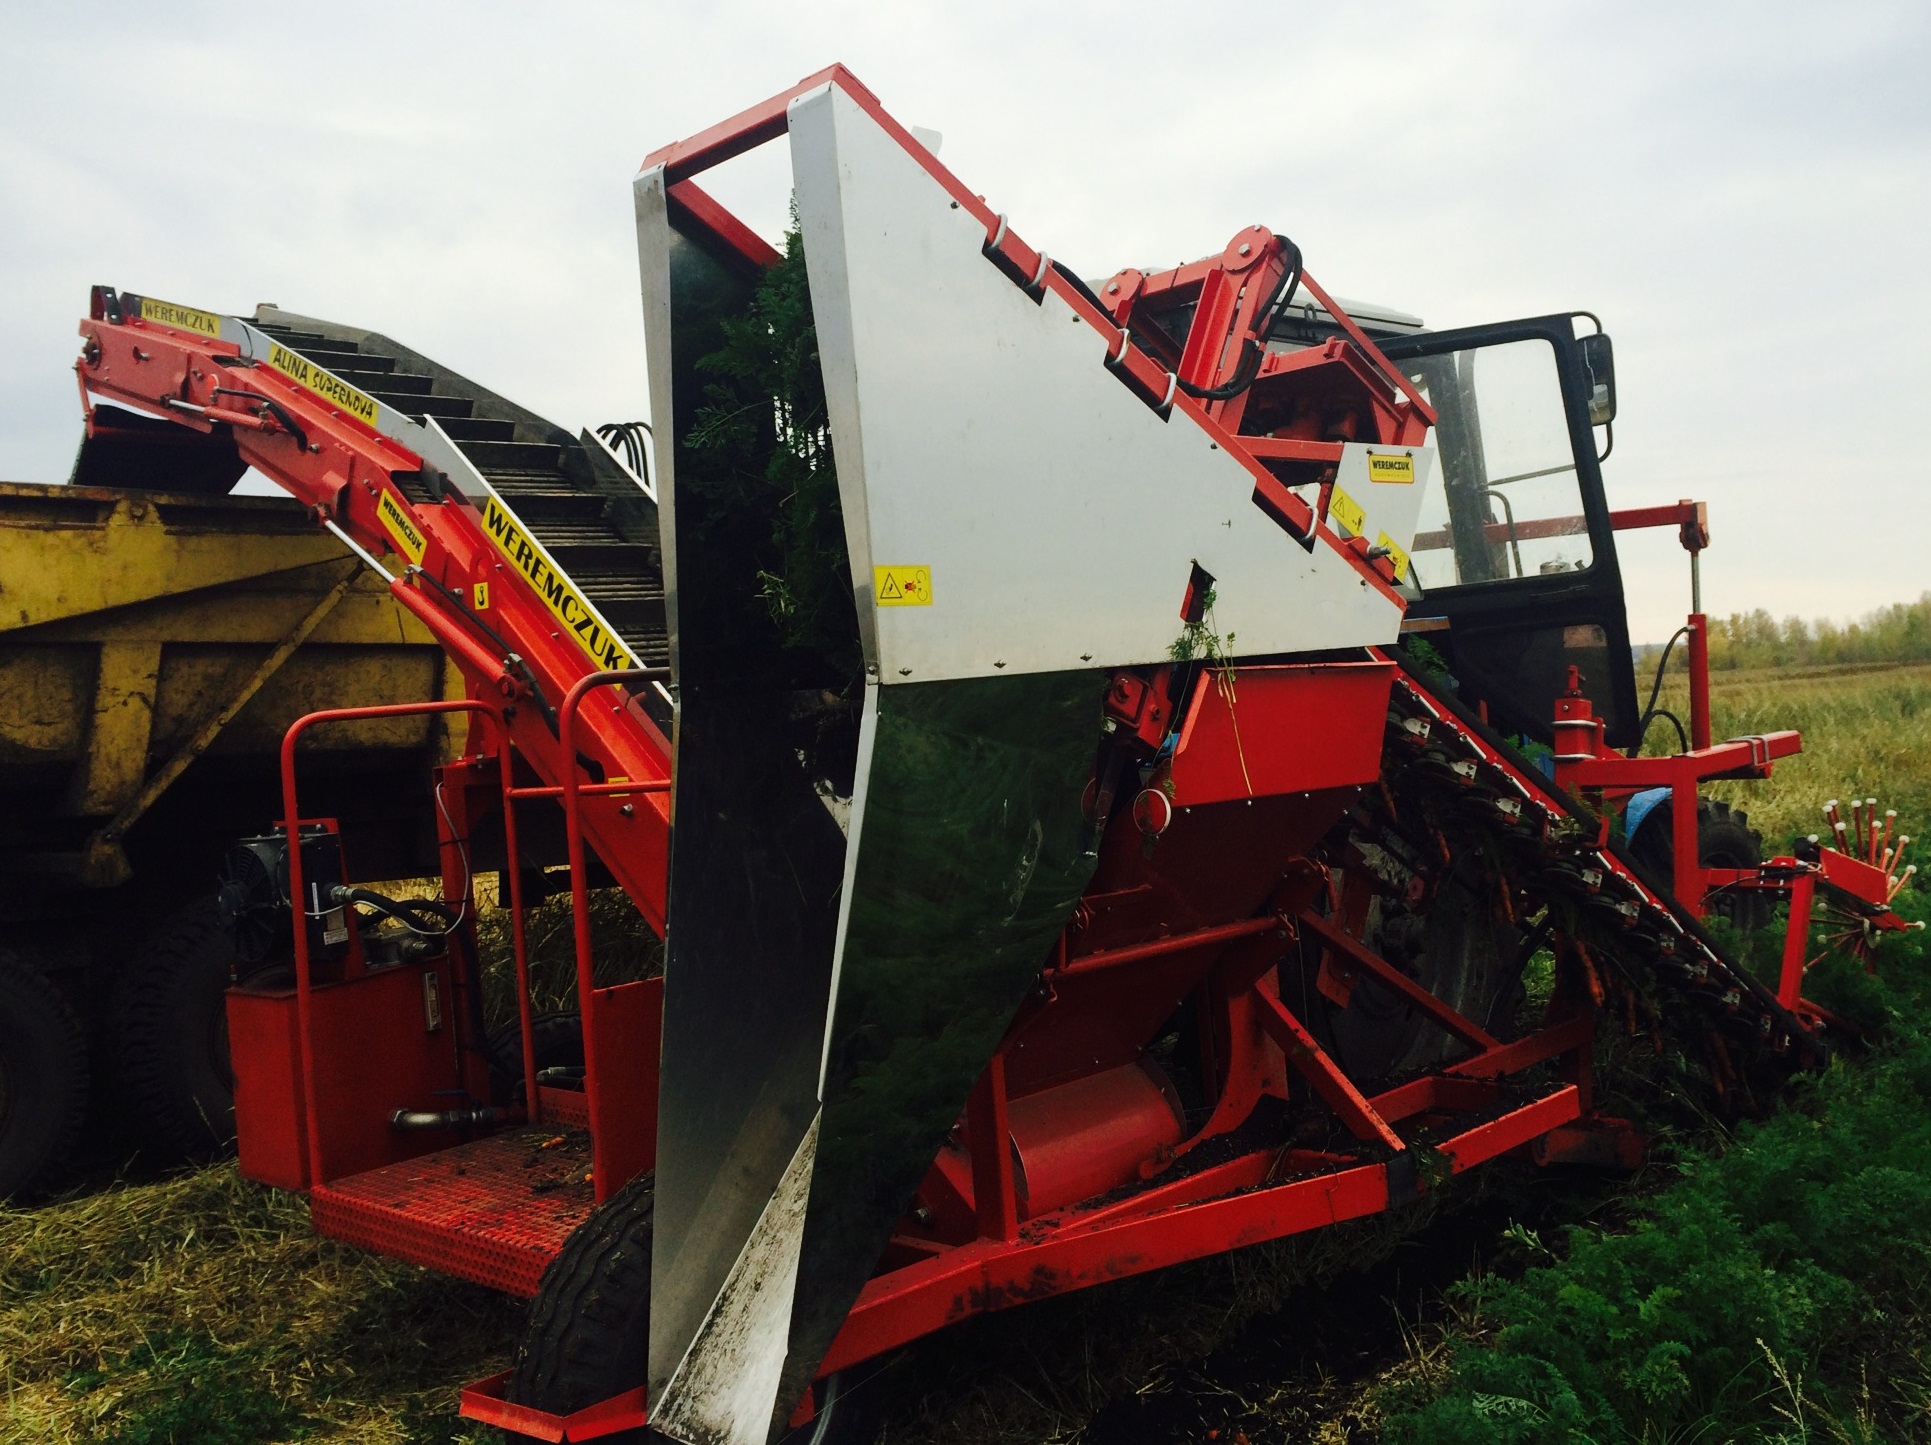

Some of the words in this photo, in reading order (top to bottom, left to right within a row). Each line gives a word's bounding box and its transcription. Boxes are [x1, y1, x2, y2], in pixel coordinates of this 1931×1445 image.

[144, 303, 215, 333] WEREMCZUK
[273, 348, 308, 383] ALINA
[313, 371, 374, 419] SUPERNOVA
[1371, 460, 1411, 471] WEREMCZUK
[383, 496, 423, 553] WEREMCZUK
[488, 503, 624, 670] WEREMCZUK
